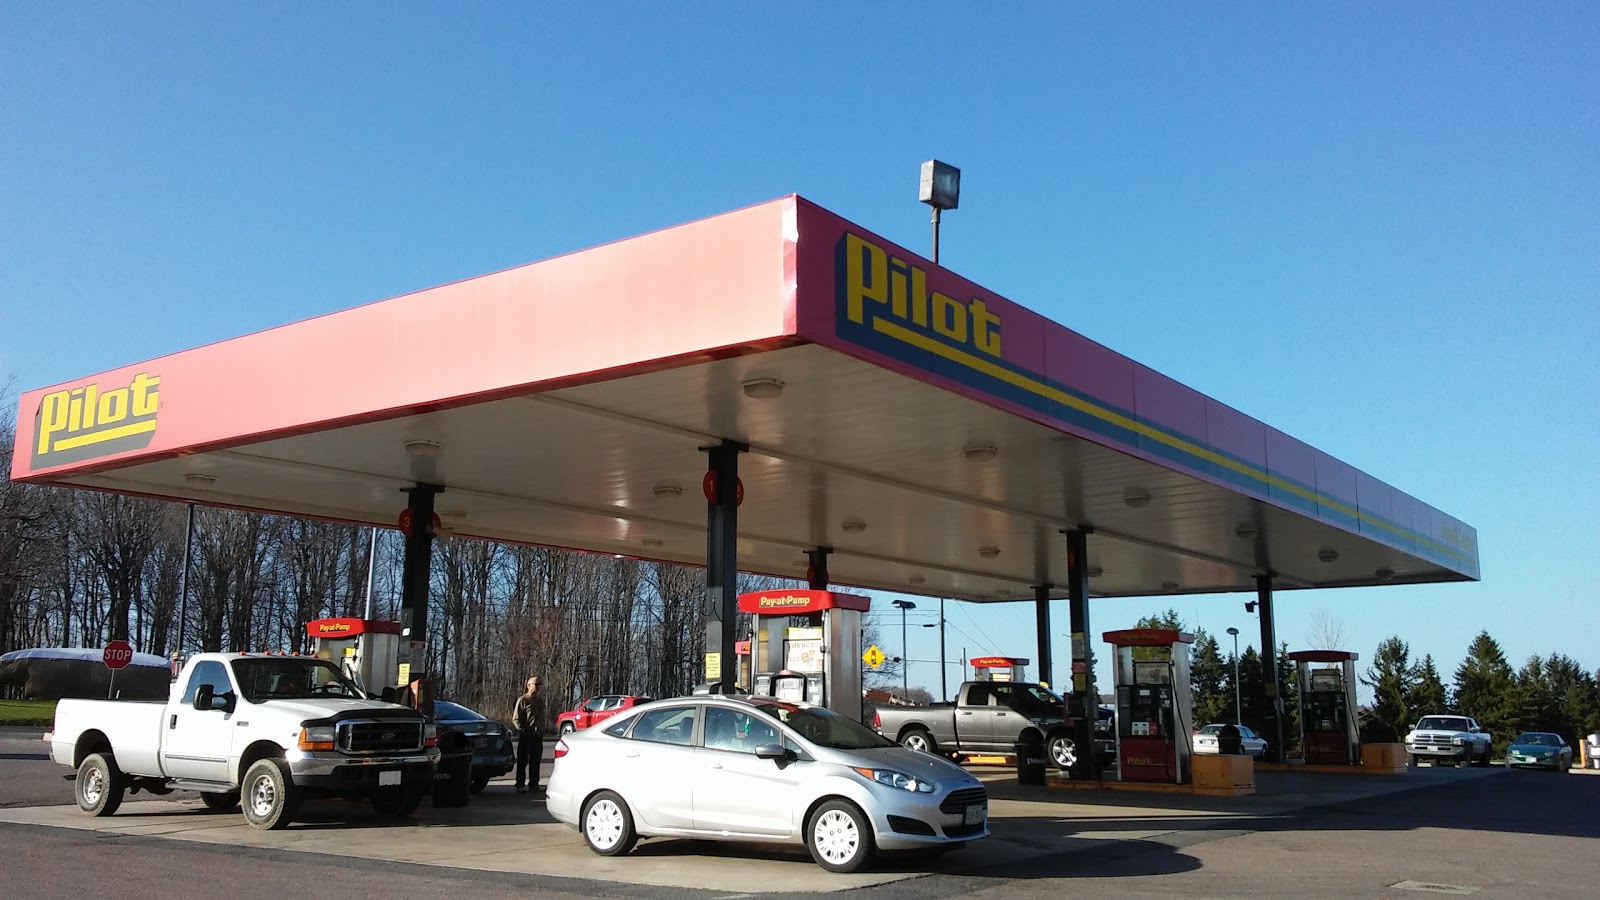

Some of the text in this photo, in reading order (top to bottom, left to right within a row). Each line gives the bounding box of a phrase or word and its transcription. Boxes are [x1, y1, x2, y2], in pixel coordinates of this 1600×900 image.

[847, 232, 1001, 358] Pilot
[38, 373, 160, 455] Pilot
[403, 516, 410, 528] 3
[104, 648, 131, 660] STOP
